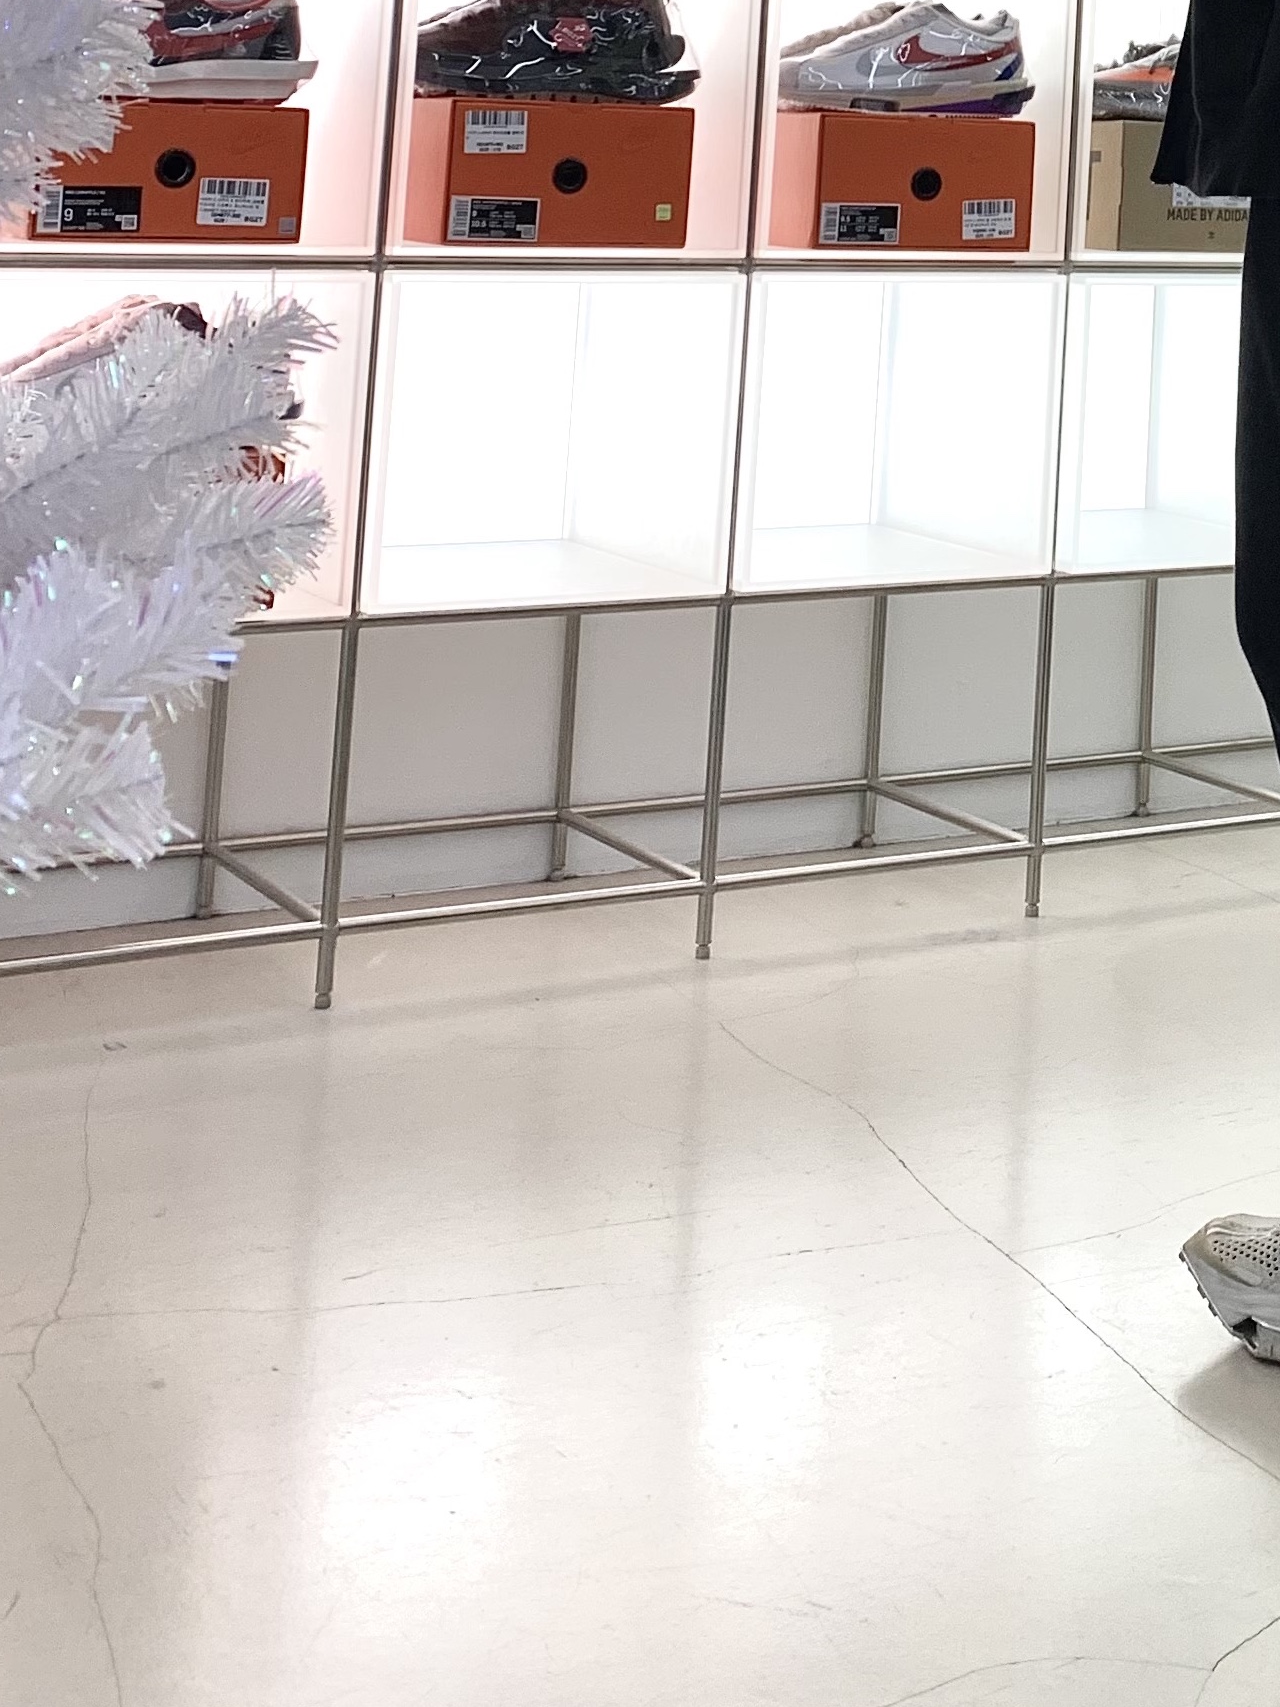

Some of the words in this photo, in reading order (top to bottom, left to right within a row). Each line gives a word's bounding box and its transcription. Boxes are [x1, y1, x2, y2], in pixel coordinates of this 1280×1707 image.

[63, 207, 74, 222] 9
[1167, 208, 1197, 221] MADE
[1200, 209, 1214, 222] BY
